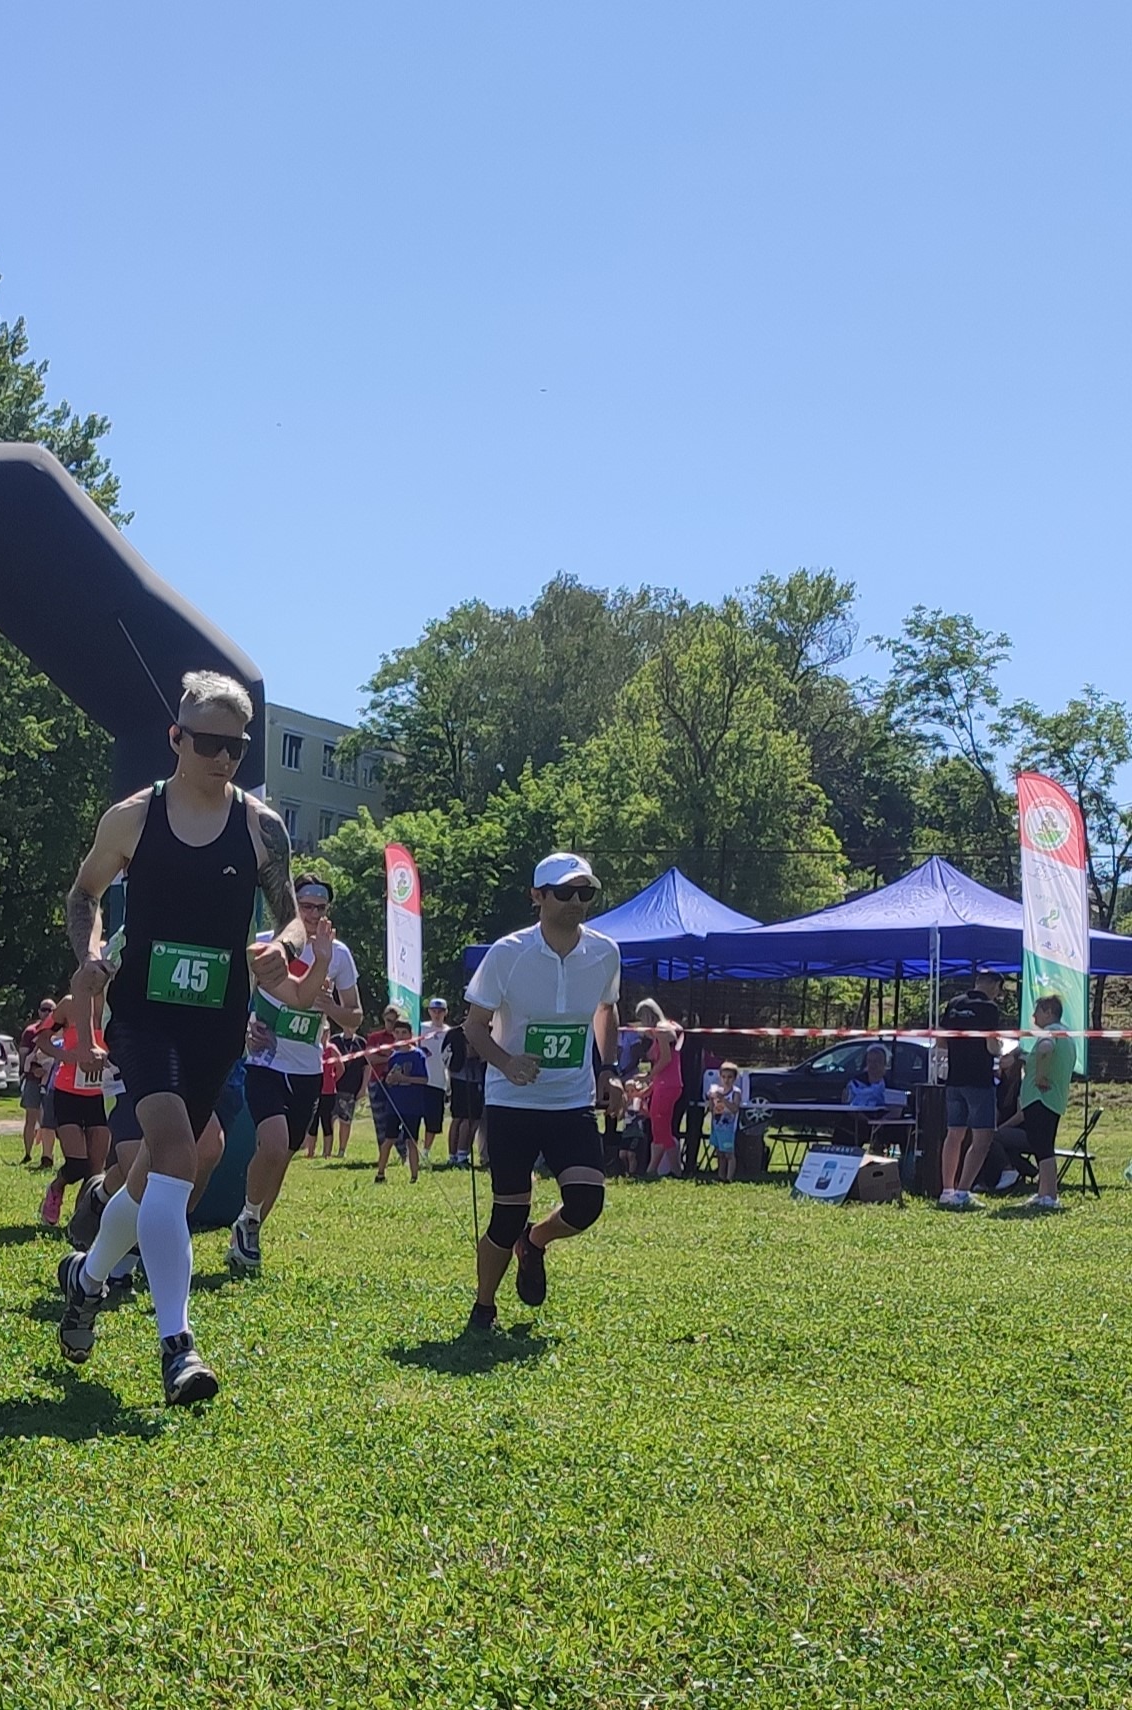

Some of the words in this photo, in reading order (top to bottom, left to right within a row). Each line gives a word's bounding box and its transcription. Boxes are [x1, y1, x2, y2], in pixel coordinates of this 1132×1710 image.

[171, 958, 209, 992] 45
[289, 1015, 311, 1035] 48
[543, 1035, 572, 1059] 32
